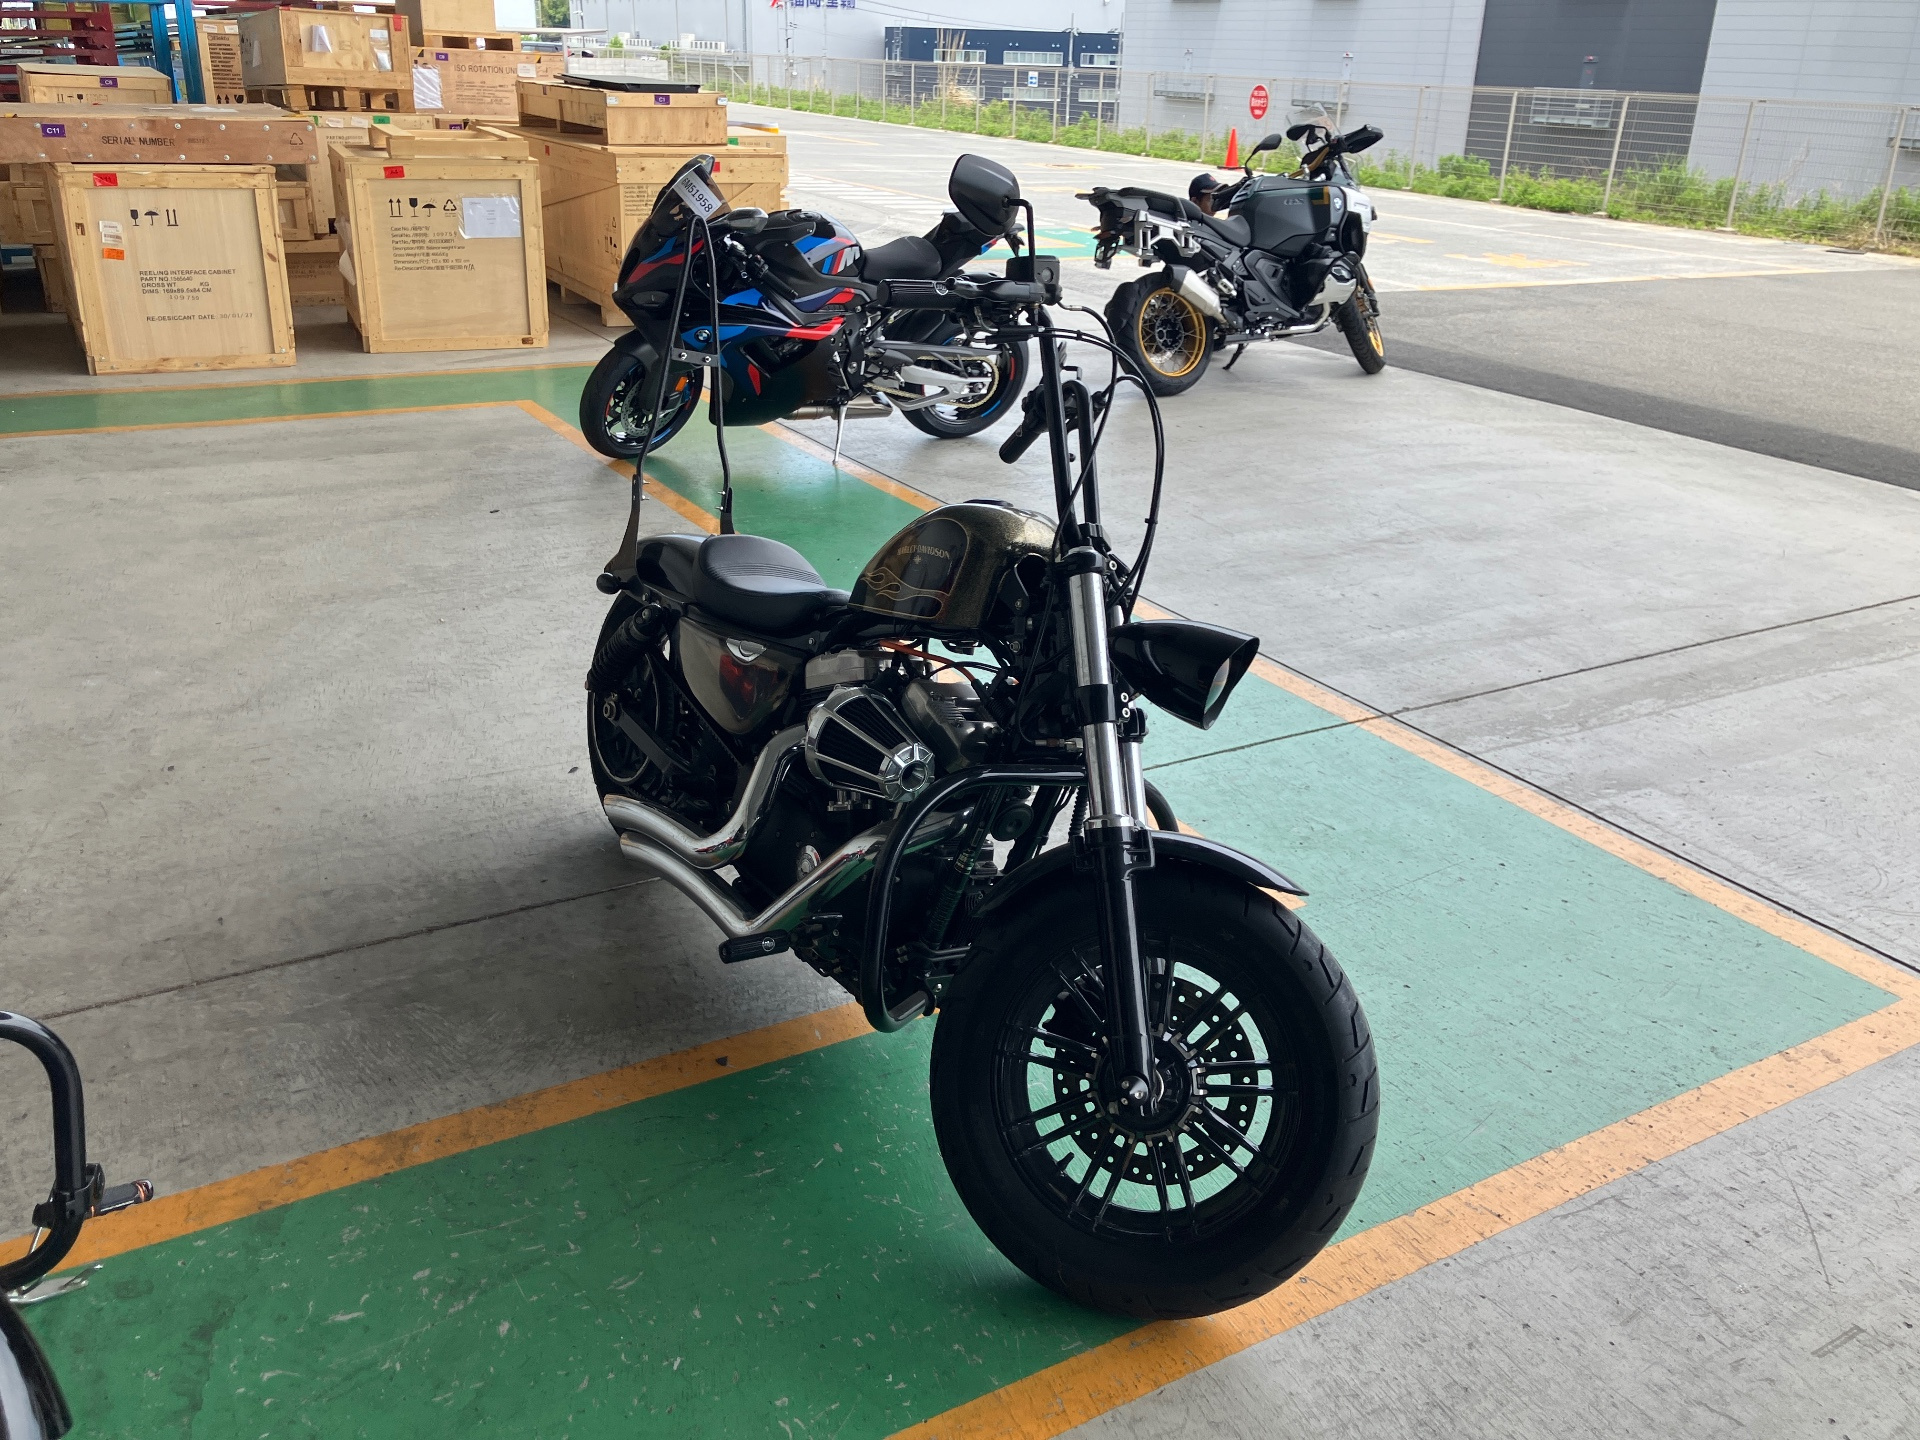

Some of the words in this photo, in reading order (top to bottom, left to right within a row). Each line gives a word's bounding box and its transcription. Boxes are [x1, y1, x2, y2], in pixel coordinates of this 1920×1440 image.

[454, 64, 467, 73] ISO
[468, 65, 504, 74] ROTATION
[101, 136, 135, 146] SERIAL
[138, 137, 175, 147] NUMBER
[680, 176, 714, 213] 6M51958
